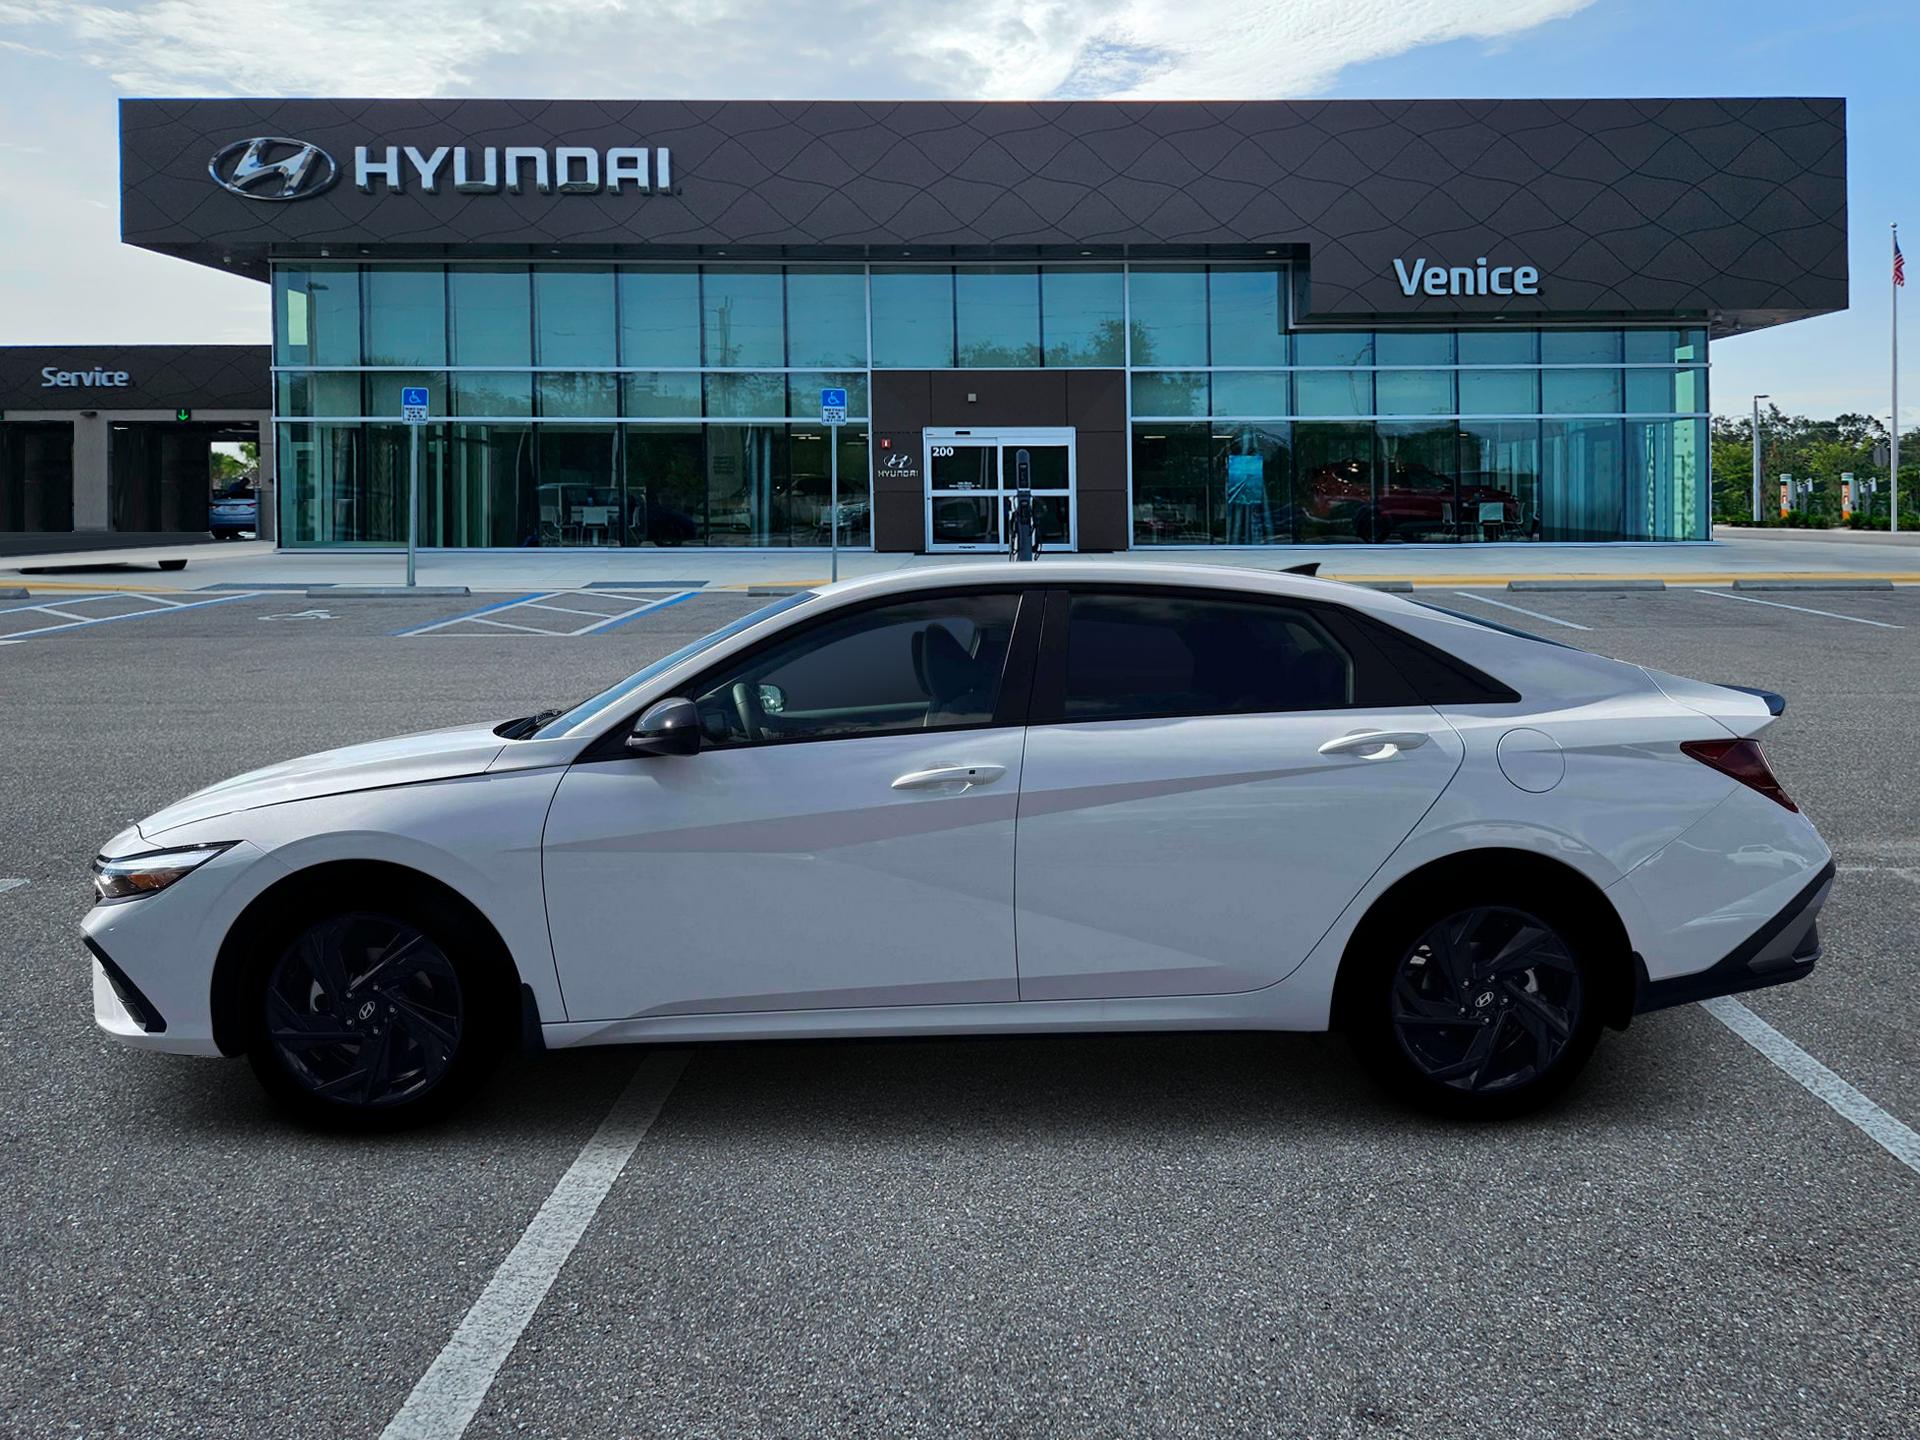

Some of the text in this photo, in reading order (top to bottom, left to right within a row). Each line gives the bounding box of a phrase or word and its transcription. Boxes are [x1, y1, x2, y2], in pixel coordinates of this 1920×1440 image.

[354, 146, 670, 195] HYUNDAI
[1392, 256, 1539, 296] Venice
[41, 366, 130, 387] Service
[932, 447, 954, 457] 200
[878, 470, 919, 478] HYUNDAI
